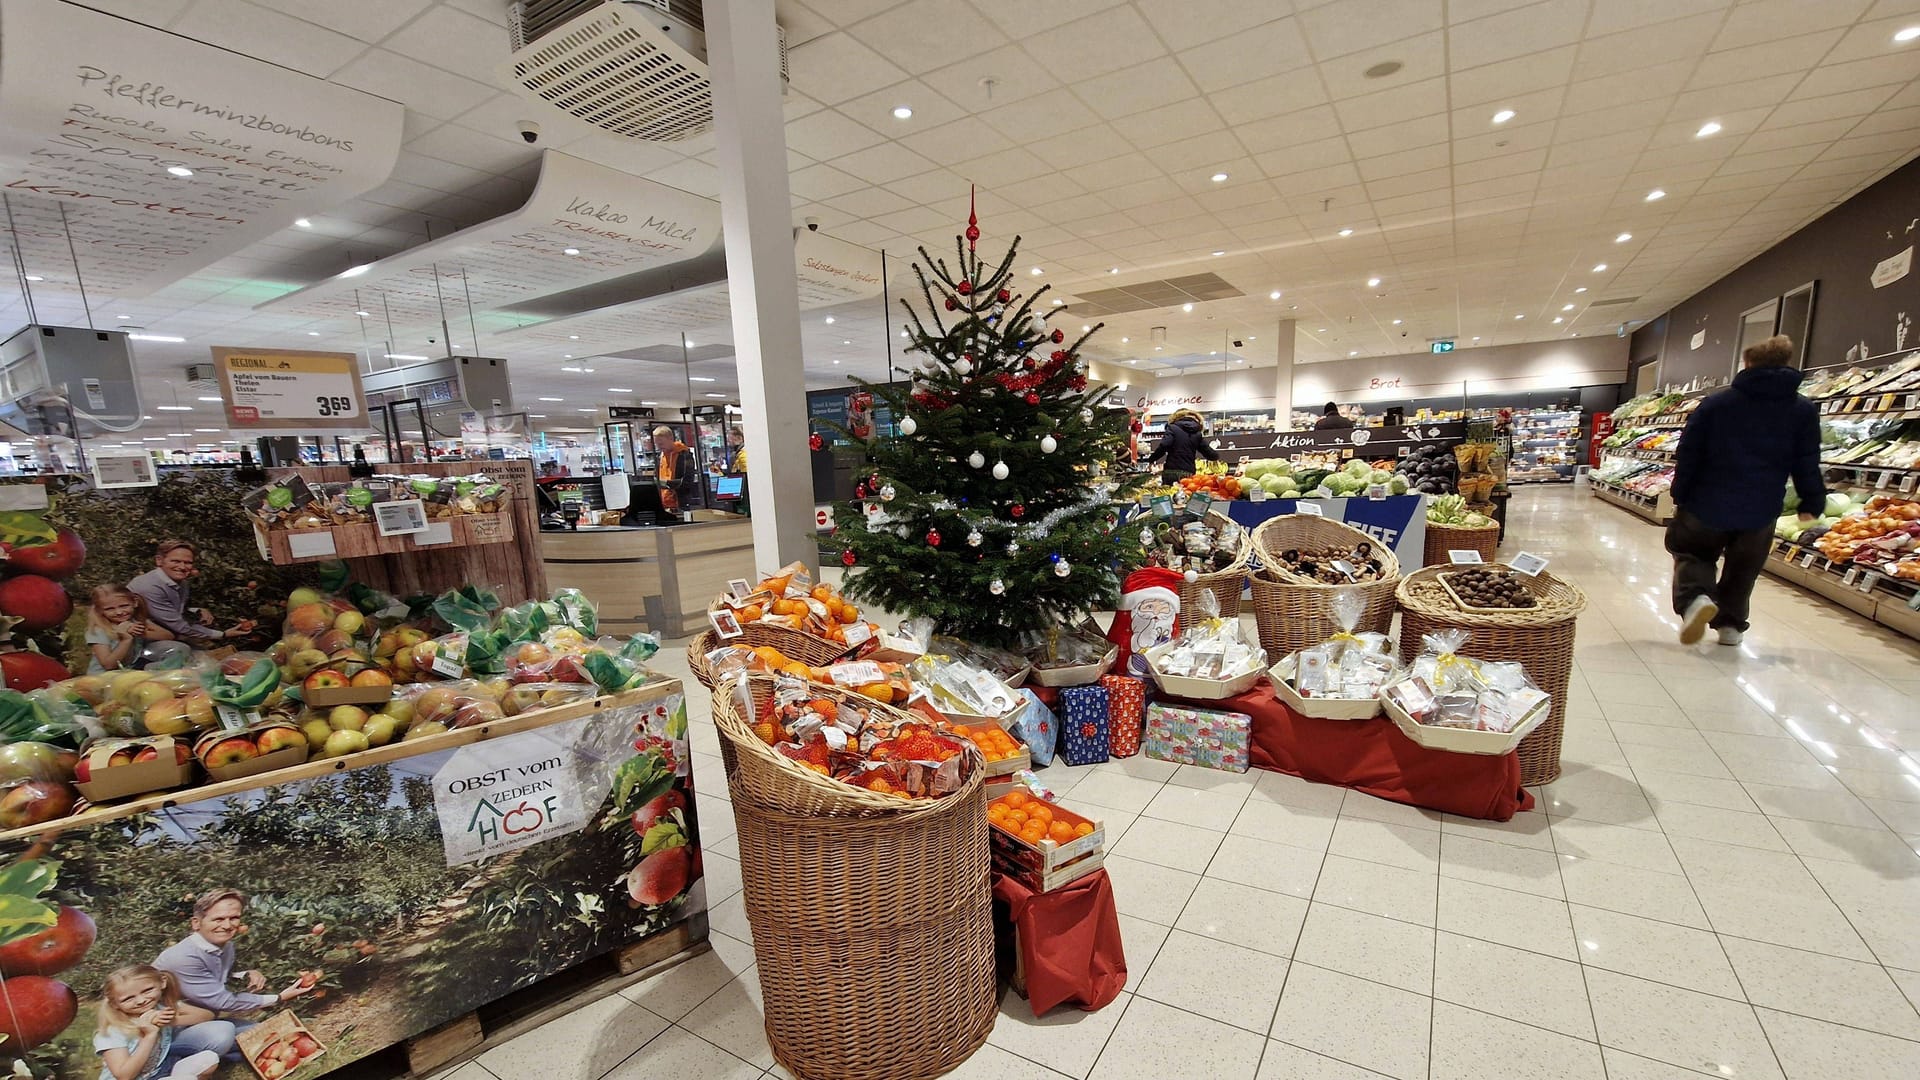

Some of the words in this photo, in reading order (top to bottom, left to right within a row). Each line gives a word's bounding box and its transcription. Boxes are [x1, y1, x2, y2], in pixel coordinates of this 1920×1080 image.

[76, 66, 354, 152] Pfefferminzbonbons
[69, 103, 168, 134] Rucola
[184, 131, 252, 153] Salat
[265, 150, 343, 175] Erbsen
[4, 179, 245, 225] Karotten
[565, 196, 629, 224] Kakao
[641, 215, 697, 243] Milch
[230, 358, 268, 369] REGIONAL
[1369, 377, 1401, 390] Brot
[1270, 434, 1315, 450] Aktion
[480, 466, 503, 474] Obst
[448, 767, 511, 795] OBST
[517, 756, 562, 777] vom
[491, 778, 554, 805] ZEDERN
